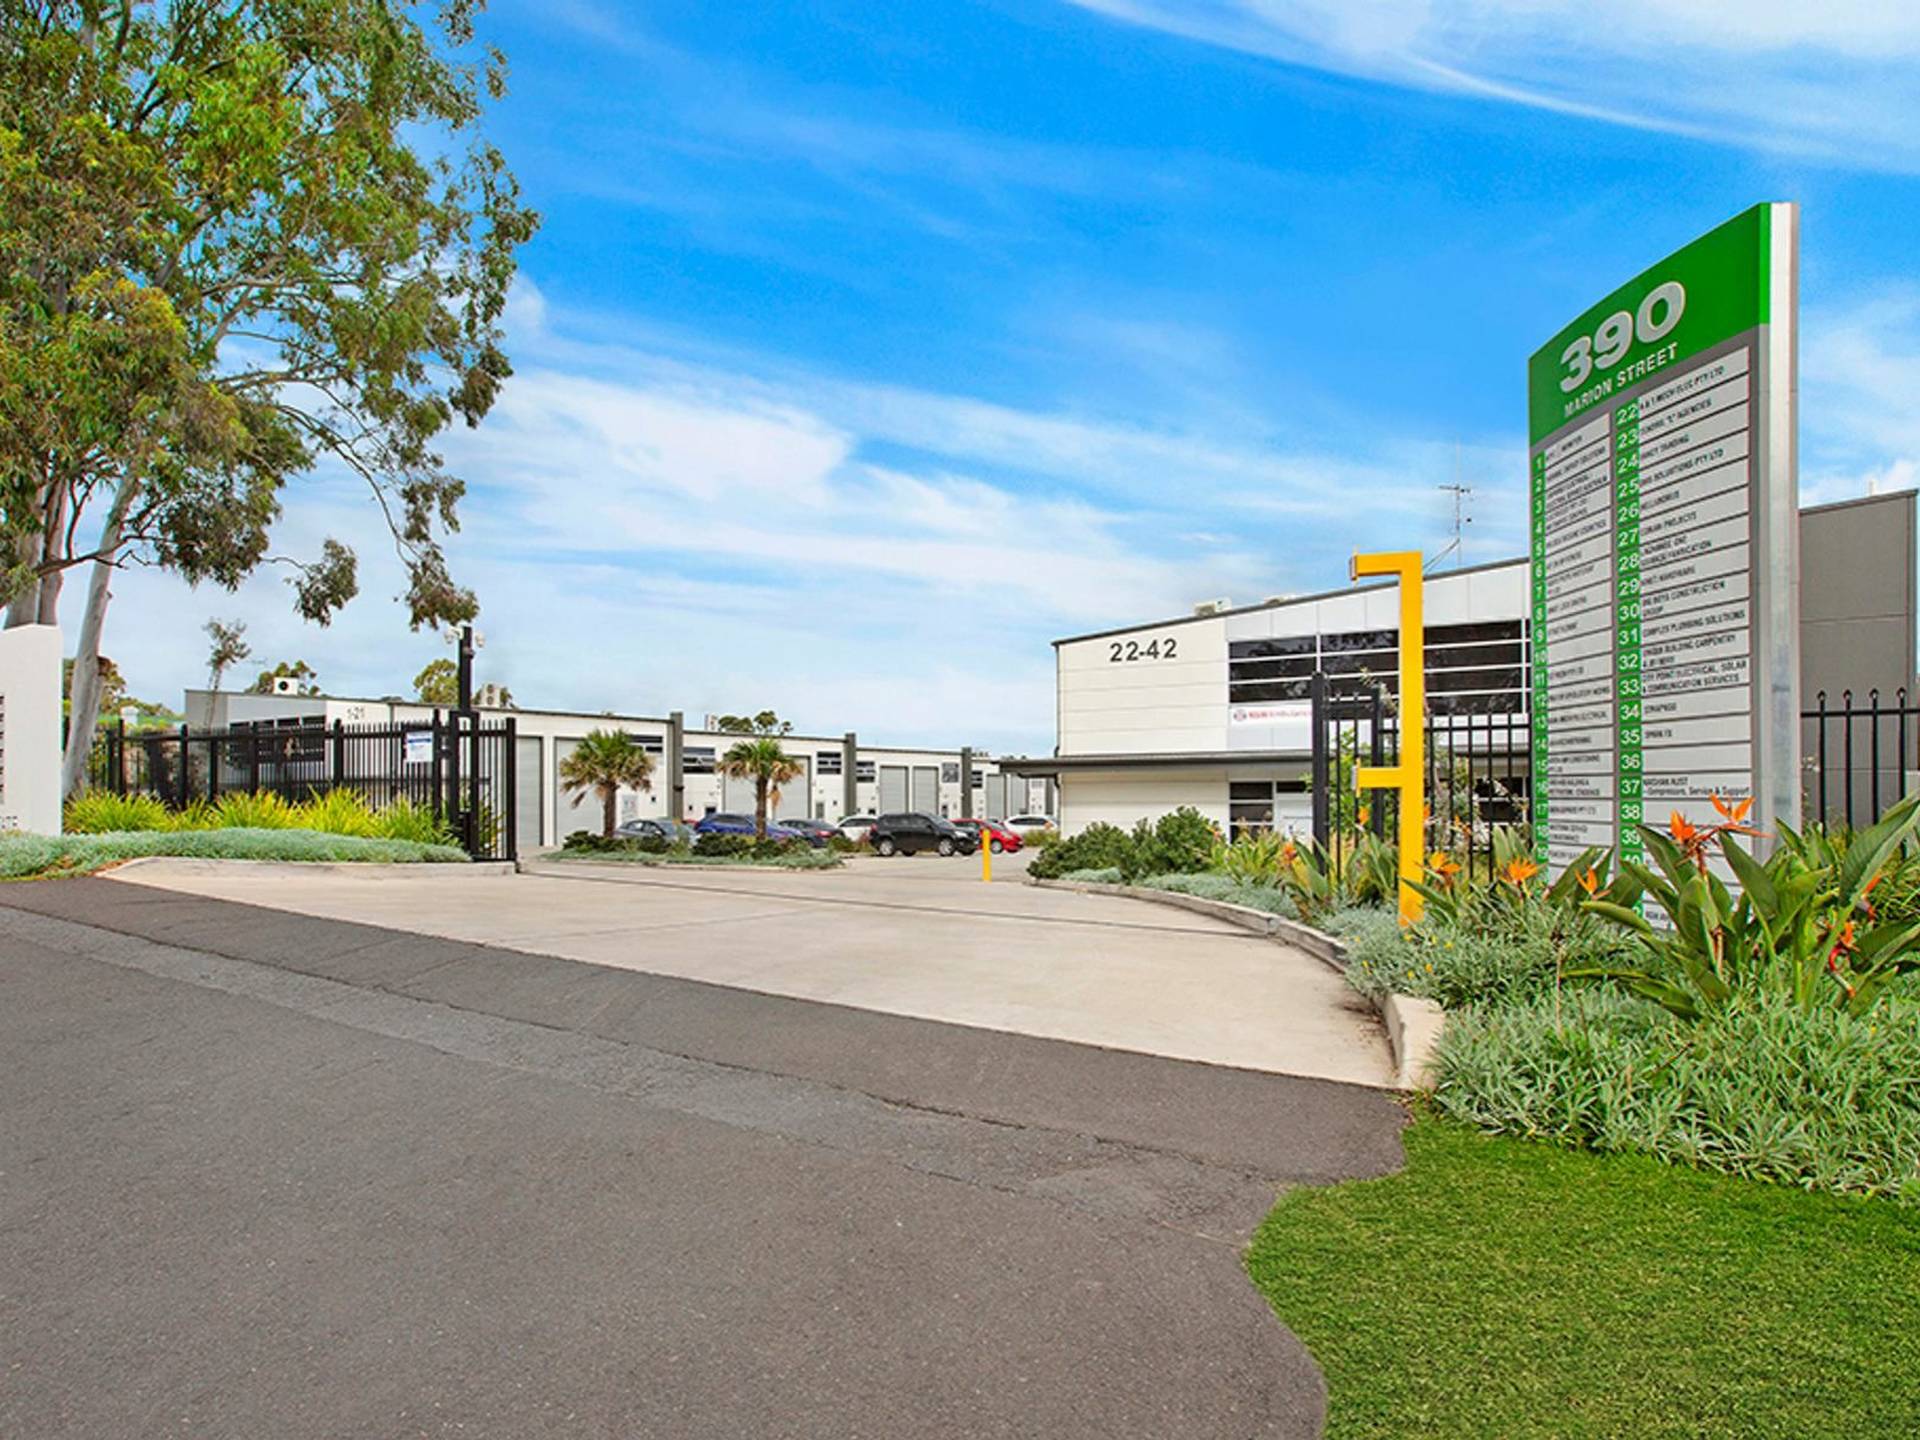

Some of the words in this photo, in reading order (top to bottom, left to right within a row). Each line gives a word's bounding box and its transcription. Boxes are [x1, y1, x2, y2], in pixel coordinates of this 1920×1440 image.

[1560, 281, 1686, 393] 390
[1564, 378, 1612, 418] MARION
[1617, 342, 1678, 387] STREET
[1616, 403, 1639, 425] 22
[1616, 428, 1639, 449] 23
[1537, 457, 1541, 469] 1
[1617, 453, 1639, 474] 24
[1617, 478, 1639, 499] 25
[1617, 502, 1639, 523] 26
[1618, 528, 1638, 547] 27
[1618, 553, 1639, 572] 28
[1618, 578, 1639, 596] 29
[1671, 580, 1725, 600] CONSTRUCTION
[1618, 603, 1639, 621] 30
[1536, 629, 1543, 643] 9
[1619, 628, 1638, 645] 31
[1110, 638, 1177, 662] 22-42
[1619, 653, 1638, 670] 32
[1620, 679, 1639, 695] 33
[1703, 673, 1739, 686] SERVICES
[1620, 704, 1639, 720] 34
[1620, 729, 1640, 744] 35
[1620, 753, 1640, 769] 36
[1621, 780, 1640, 794] 37
[1621, 804, 1640, 819] 38
[1621, 831, 1640, 845] 39
